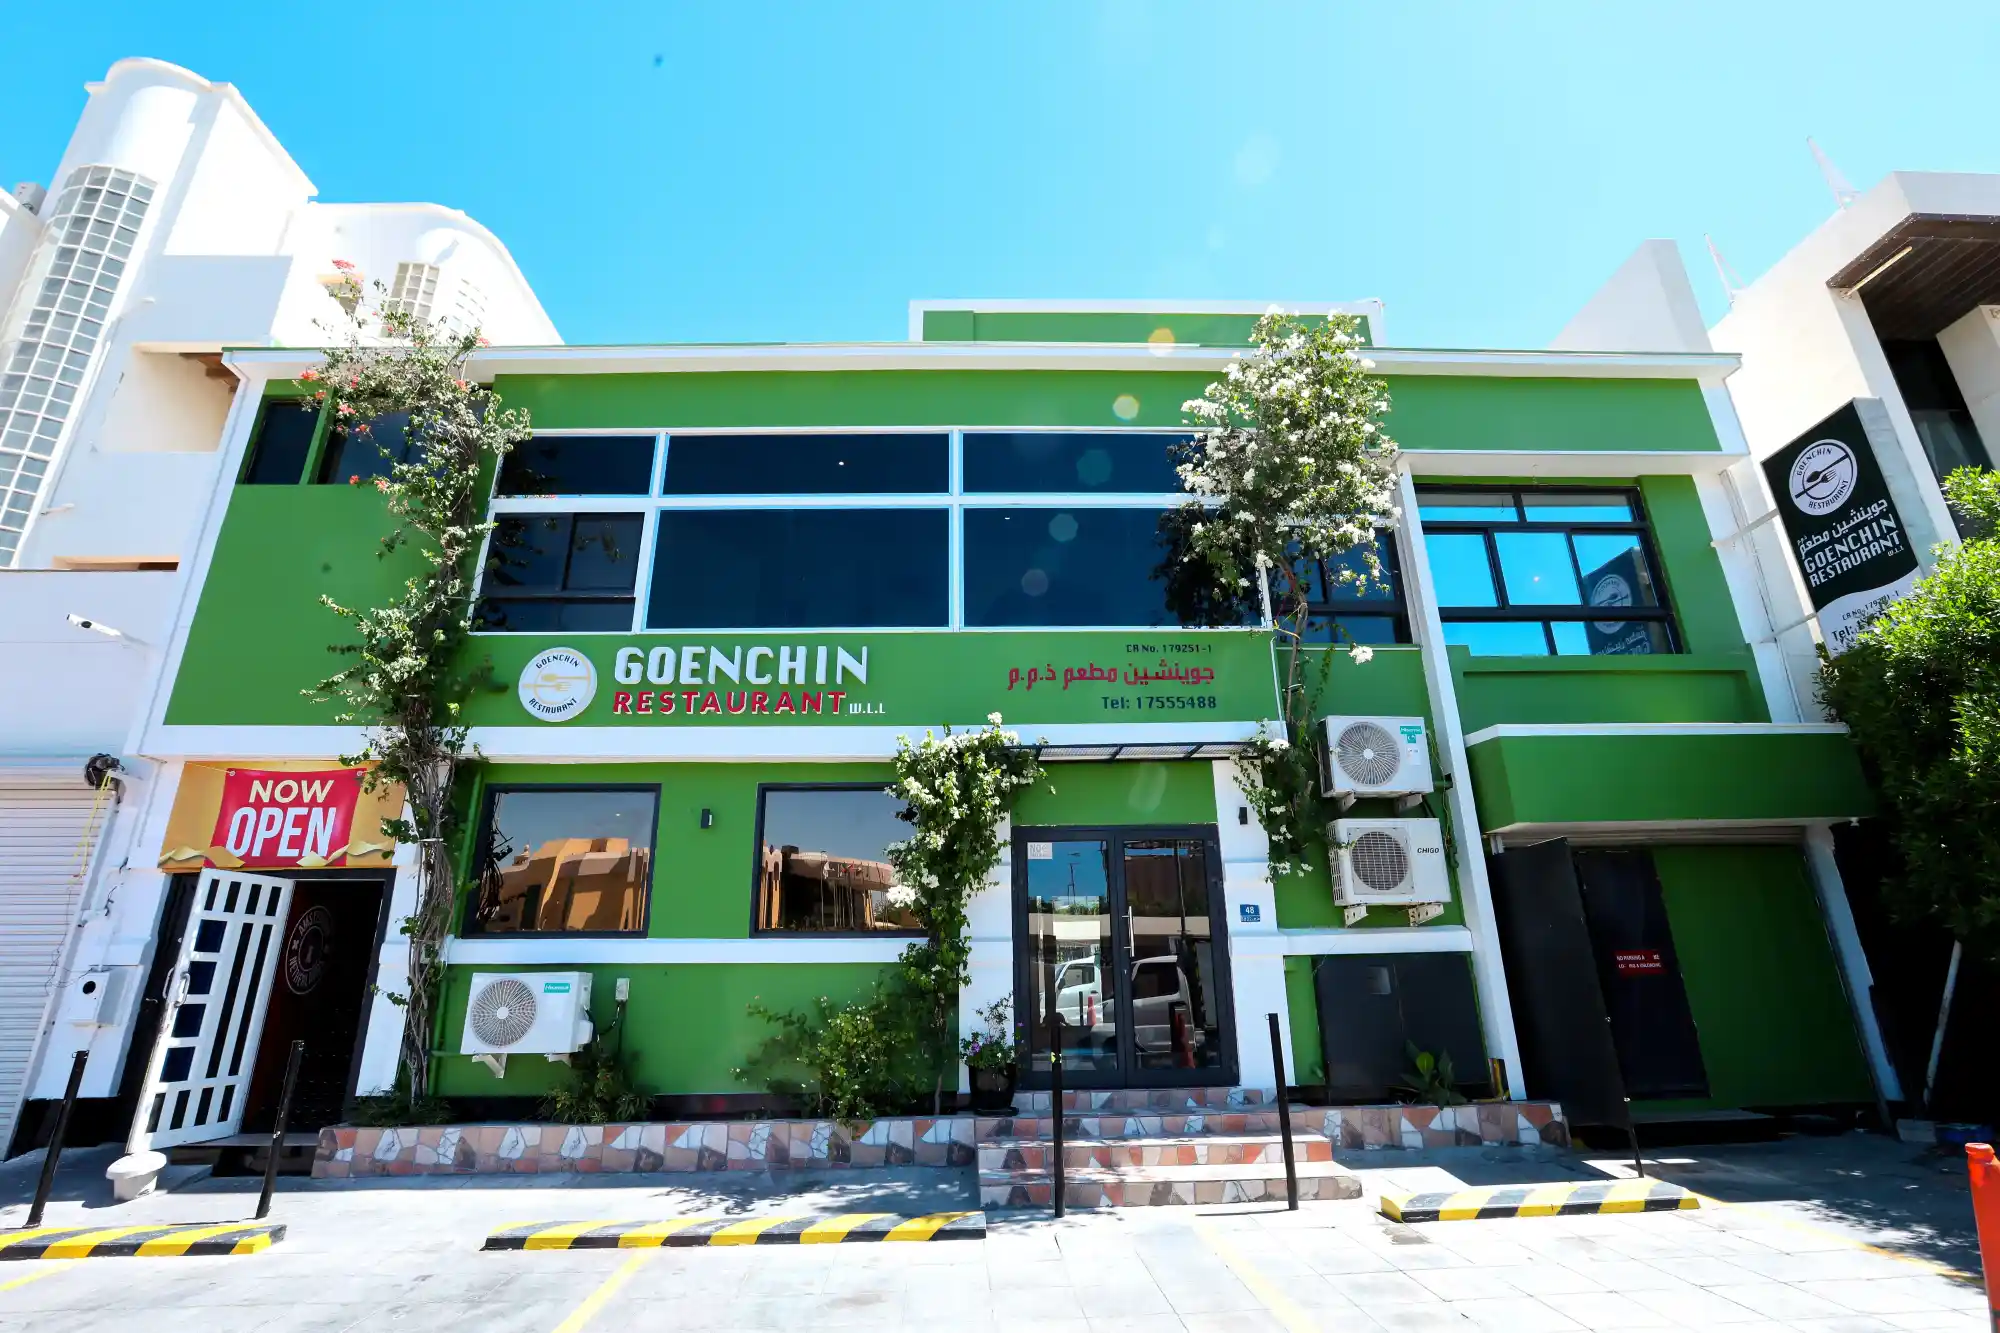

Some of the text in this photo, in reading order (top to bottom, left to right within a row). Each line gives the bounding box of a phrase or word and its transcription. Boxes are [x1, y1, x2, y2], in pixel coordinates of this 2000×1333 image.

[1797, 447, 1832, 476] GOENCHIN
[1808, 480, 1849, 510] RESTAURANT
[1832, 498, 1889, 538] جوينشين
[1799, 530, 1830, 560] مطعم
[1803, 513, 1897, 574] GOENCHIN
[1808, 530, 1900, 588] RESTAURANT
[535, 654, 580, 669] GOENCHIN
[1126, 644, 1139, 653] CR
[614, 645, 868, 685] GOENCHIN
[1063, 661, 1118, 691] مطعم
[1123, 658, 1215, 686] جوينشين
[528, 697, 578, 714] RESTAURANT
[613, 691, 847, 715] RESTAURANT
[1101, 696, 1217, 710] Tel: 17555488
[249, 779, 335, 804] NOW
[225, 806, 337, 858] OPEN
[1245, 906, 1255, 914] 48
